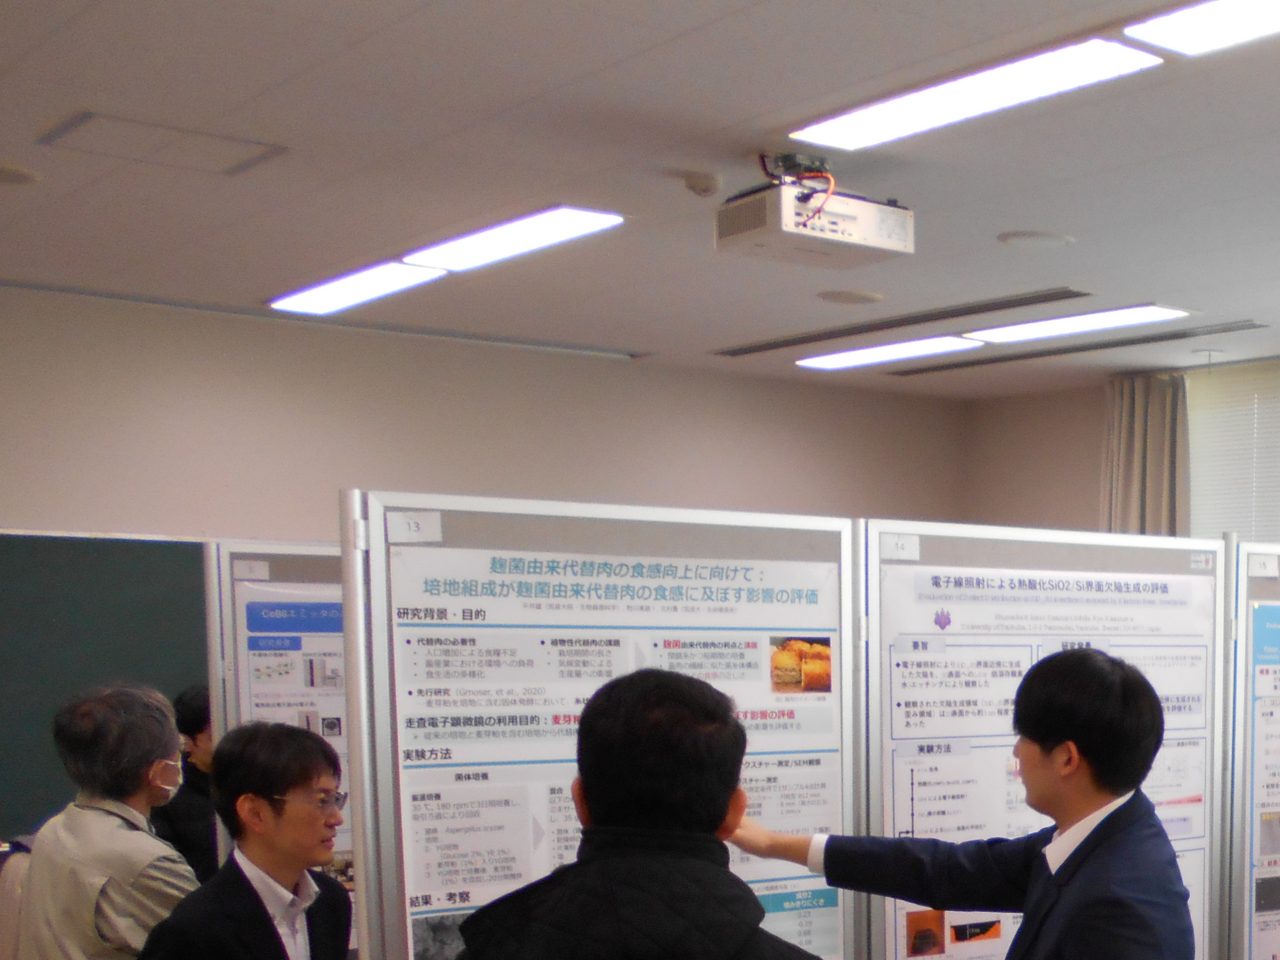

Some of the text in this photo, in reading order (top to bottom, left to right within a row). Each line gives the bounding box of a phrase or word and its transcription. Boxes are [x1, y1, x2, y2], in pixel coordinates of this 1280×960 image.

[407, 522, 420, 532] 13
[489, 557, 765, 582] 麹菌由来代替肉の食感向上に向けて：
[423, 578, 819, 604] 培地組成が麹菌由来代替肉の食感に及ぼす影響の評価
[397, 608, 486, 621] 研究背景・目的
[417, 638, 476, 646] 代替肉の必要性
[403, 748, 452, 761] 実験方法
[917, 744, 951, 754] 実験方法
[410, 891, 470, 907] 結果・考察
